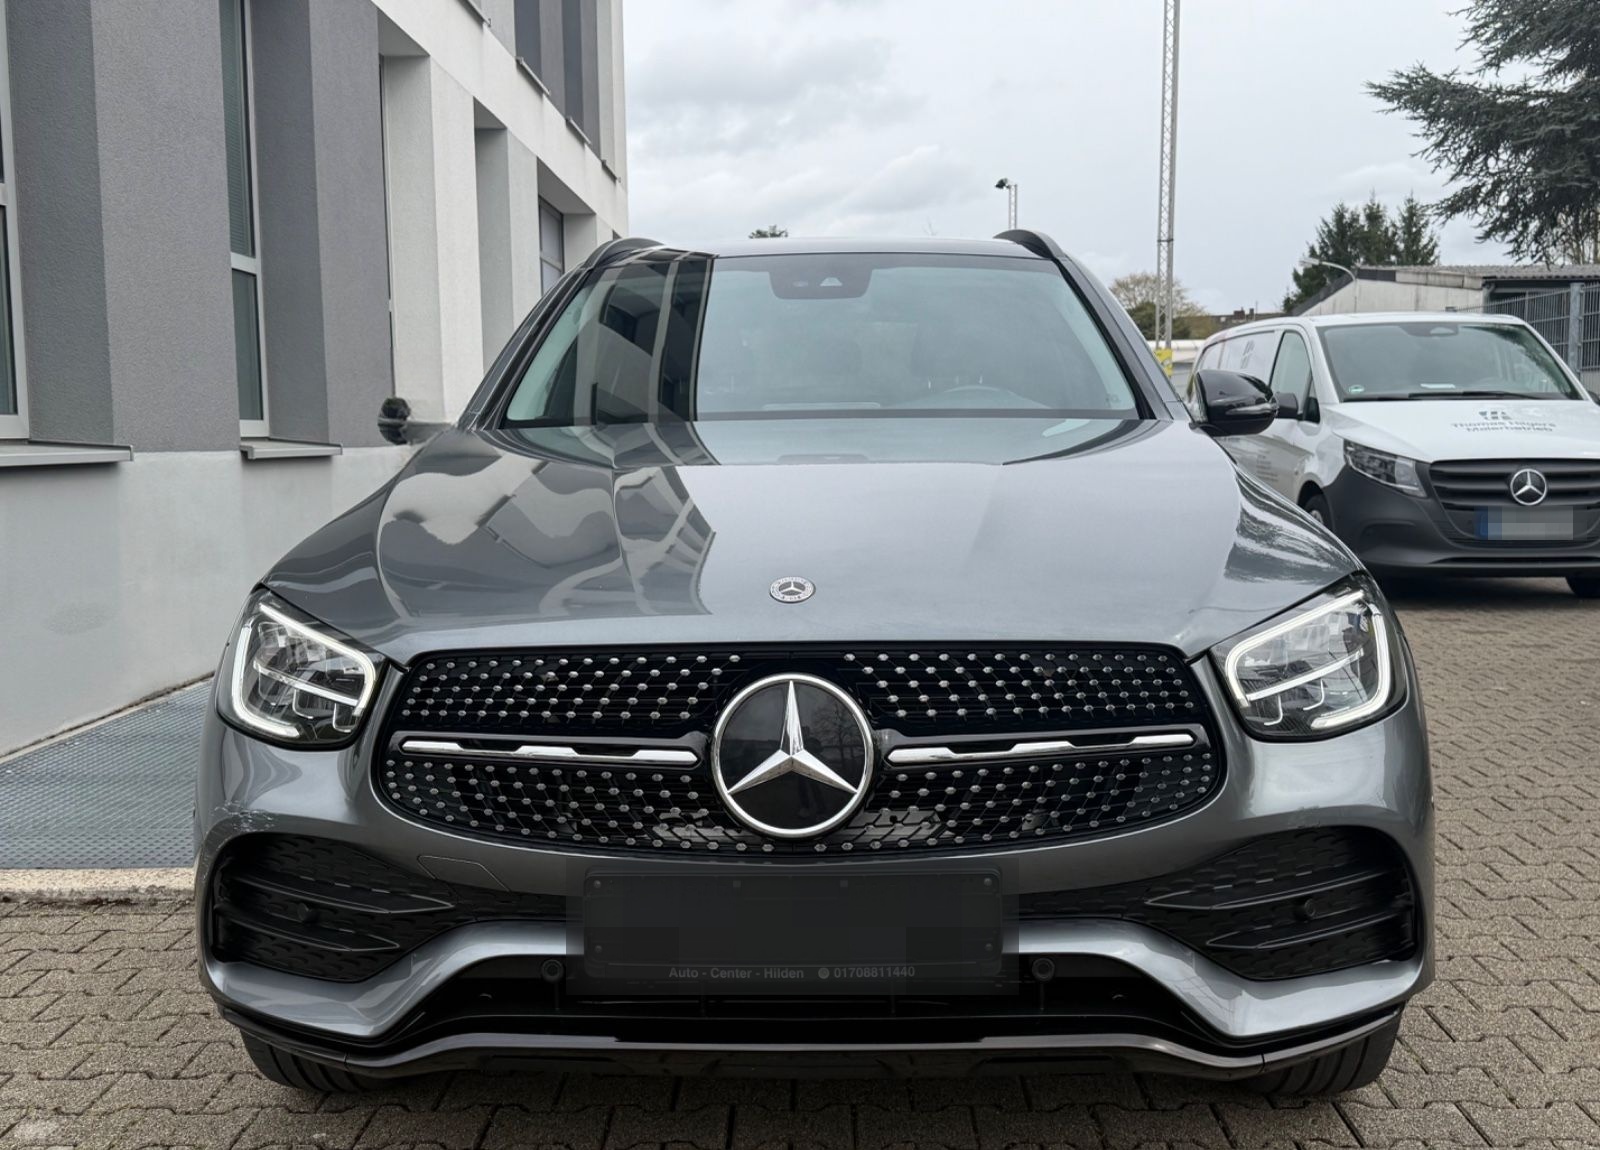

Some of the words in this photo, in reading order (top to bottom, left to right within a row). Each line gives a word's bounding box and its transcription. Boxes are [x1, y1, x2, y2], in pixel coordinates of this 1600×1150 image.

[668, 967, 699, 978] Auto
[710, 967, 752, 979] Center
[764, 967, 804, 979] Hilden
